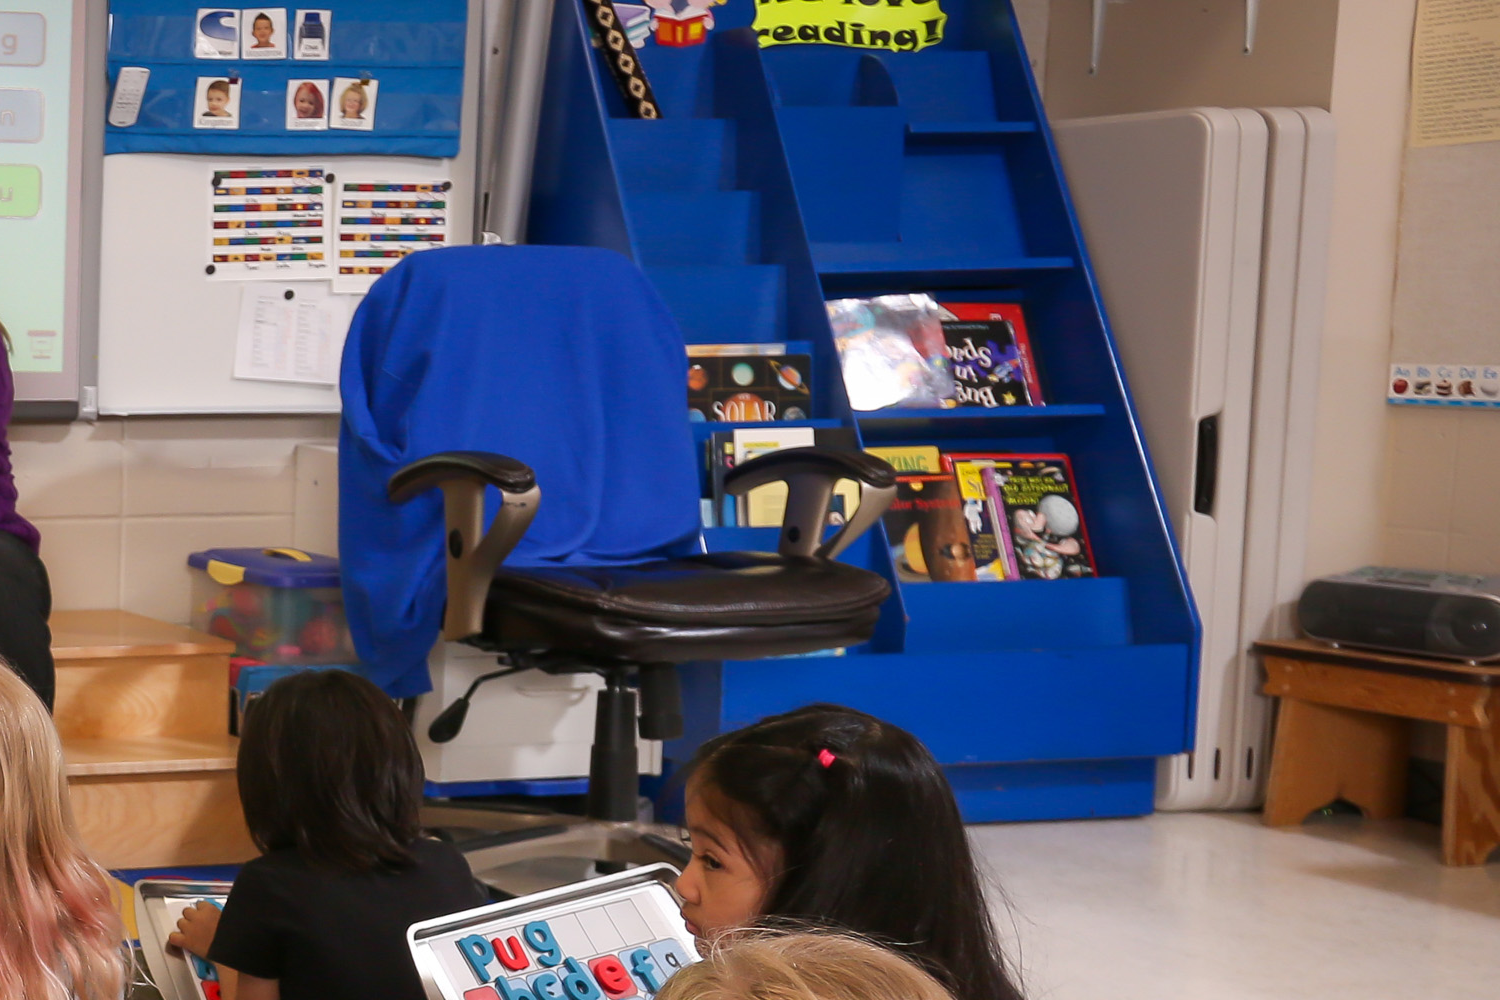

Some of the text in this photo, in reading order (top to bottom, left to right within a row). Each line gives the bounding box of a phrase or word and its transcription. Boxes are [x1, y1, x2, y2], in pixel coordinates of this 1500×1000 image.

[0, 33, 19, 57] g
[1, 110, 16, 127] n
[712, 400, 777, 421] SOLAR
[458, 920, 562, 983] pug
